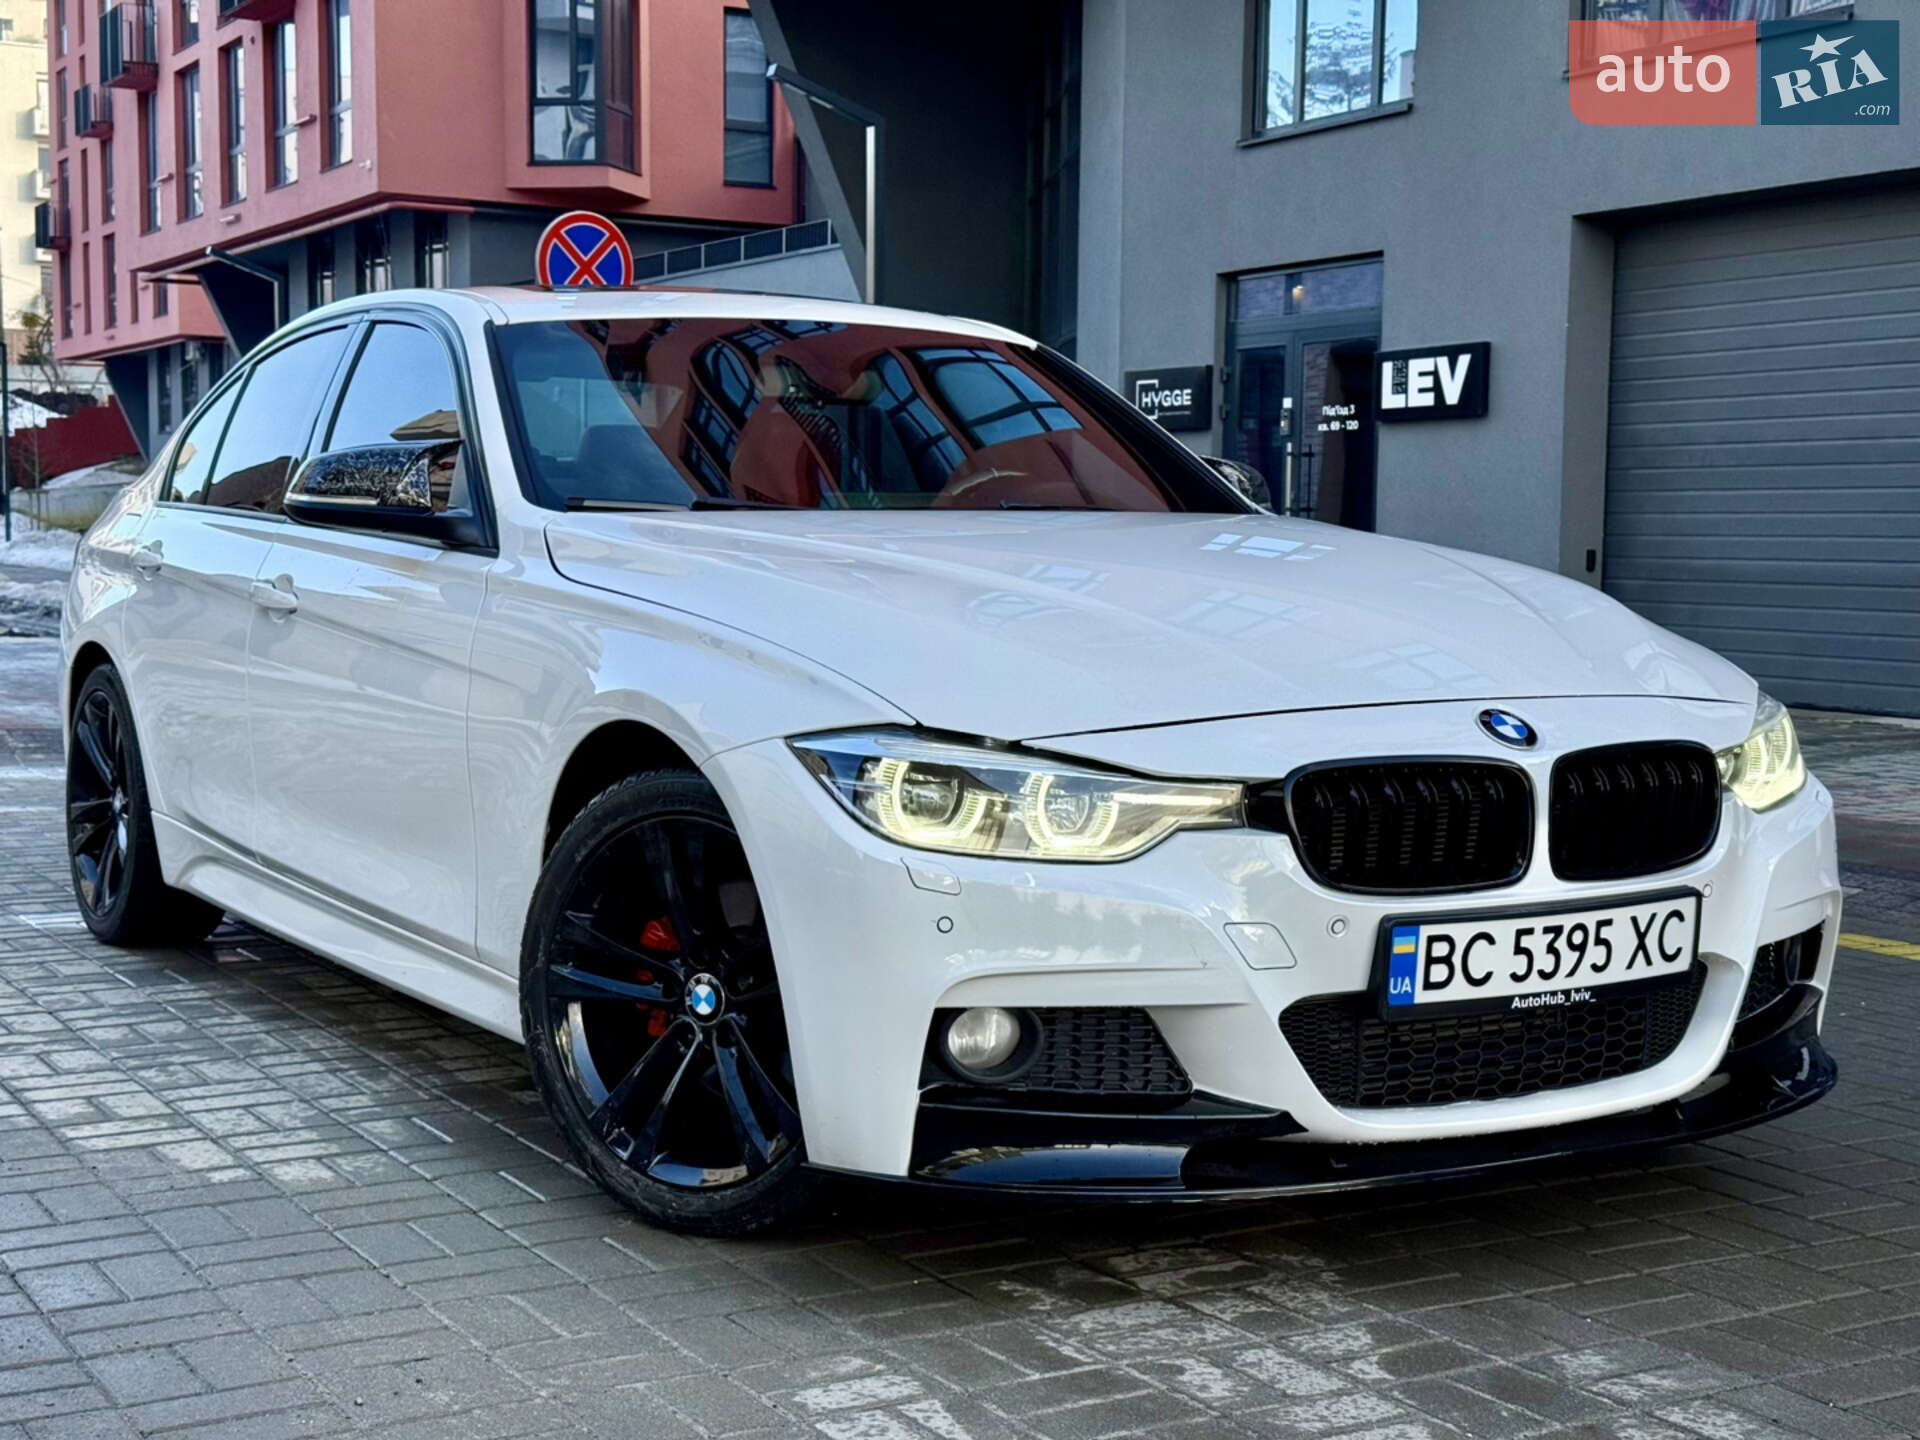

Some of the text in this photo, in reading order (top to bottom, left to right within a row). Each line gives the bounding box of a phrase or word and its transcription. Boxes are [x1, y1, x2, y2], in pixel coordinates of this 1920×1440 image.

[1141, 388, 1192, 408] HYGGE
[1381, 353, 1472, 410] LEV
[1422, 909, 1686, 991] BC 5395 XC
[1389, 977, 1413, 994] UA
